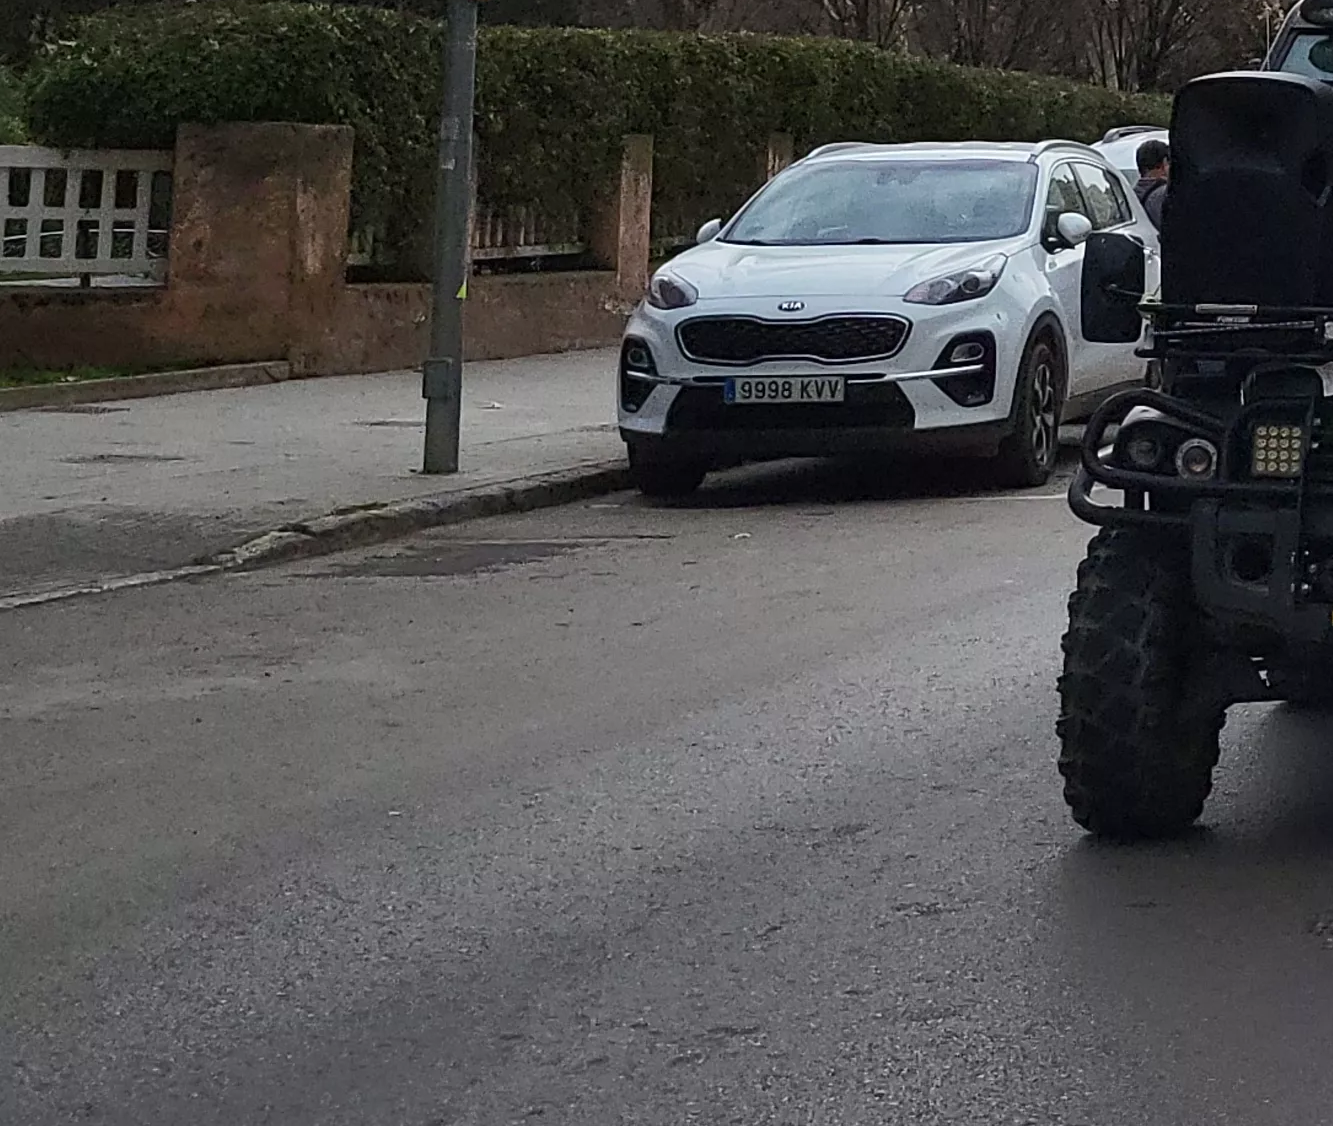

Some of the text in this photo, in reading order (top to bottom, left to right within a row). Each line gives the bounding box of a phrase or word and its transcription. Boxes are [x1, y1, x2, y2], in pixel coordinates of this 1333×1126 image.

[781, 302, 802, 310] KIA
[741, 379, 839, 400] 9998 KVV
